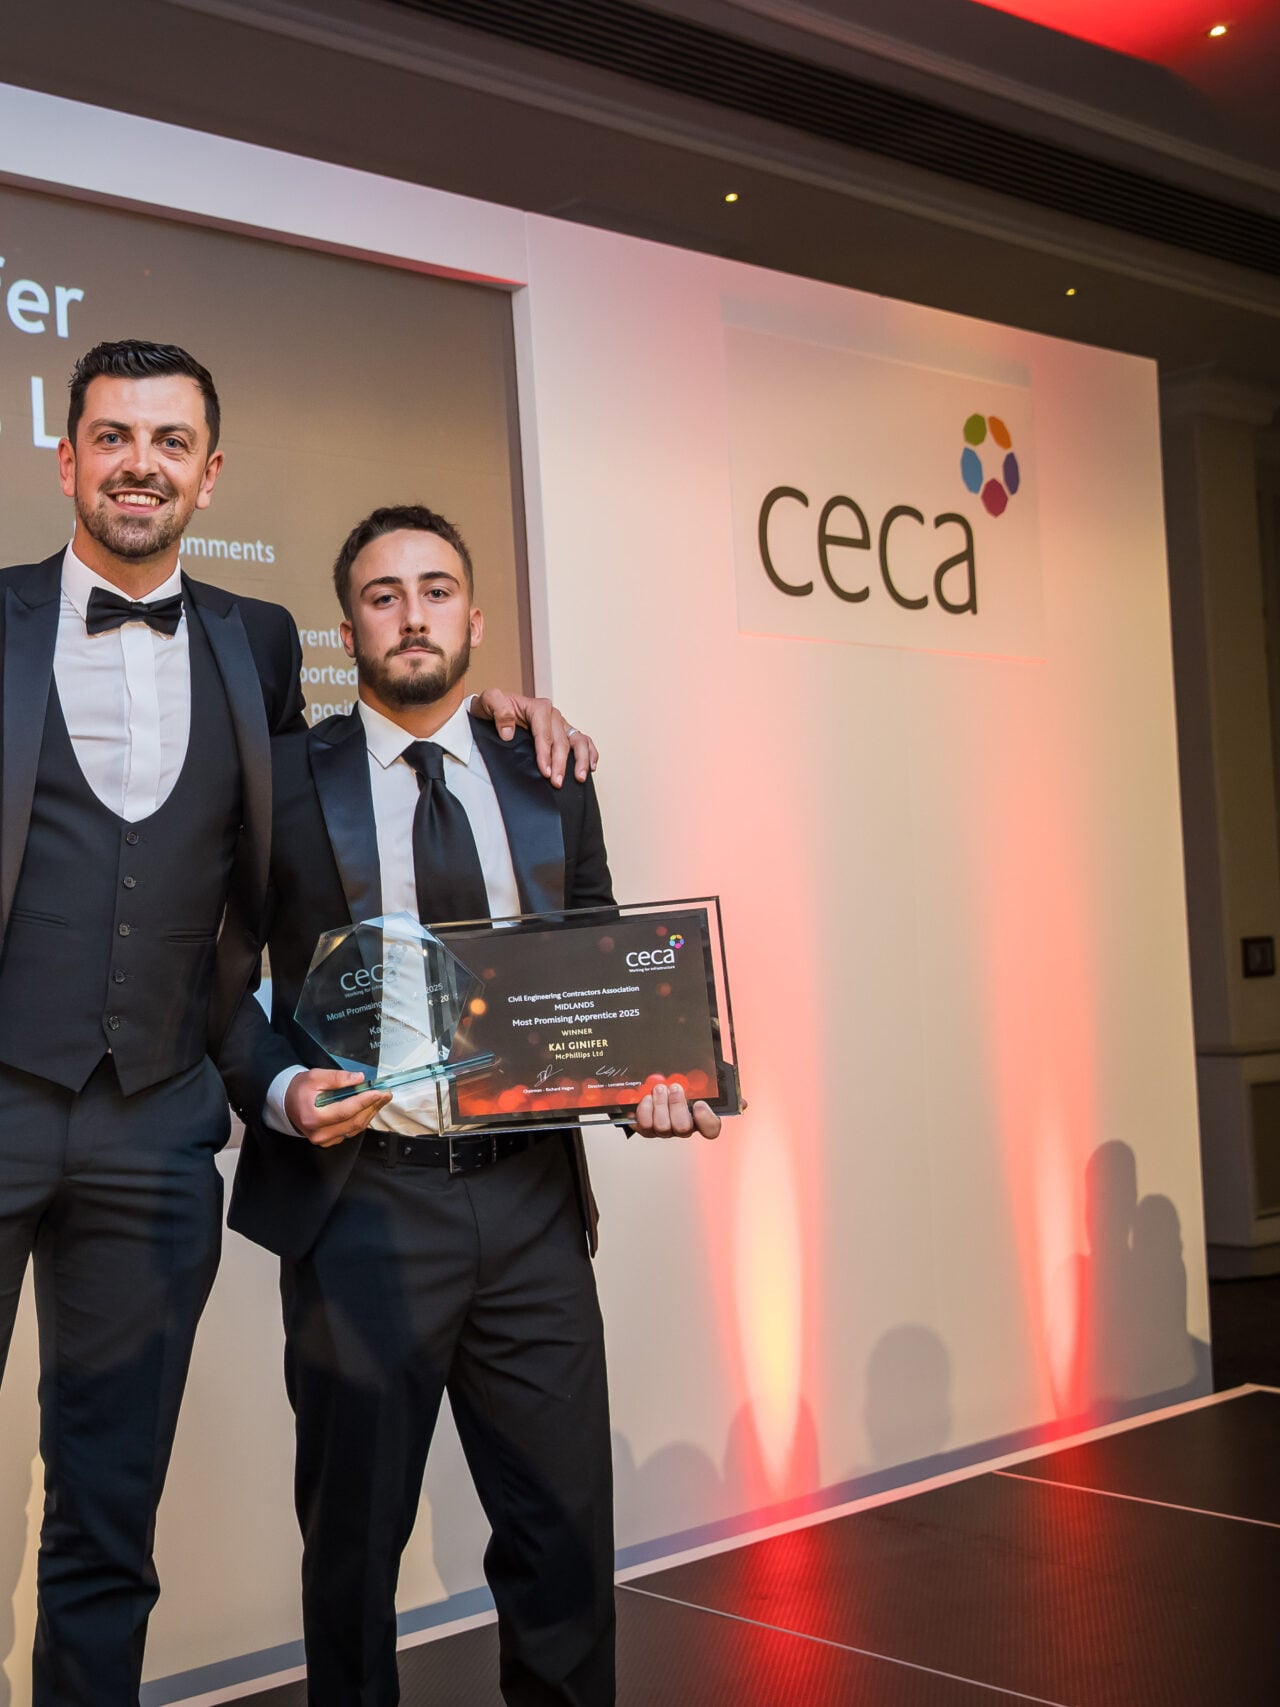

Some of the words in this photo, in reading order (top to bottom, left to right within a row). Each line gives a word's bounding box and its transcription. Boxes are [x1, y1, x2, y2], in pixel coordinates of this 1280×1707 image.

[758, 486, 977, 615] ceca
[625, 948, 675, 967] ceca
[508, 995, 523, 1003] Civil
[523, 992, 562, 1002] Engineering
[562, 989, 601, 998] Contractors
[601, 985, 640, 994] Association
[326, 1009, 345, 1022] Most
[346, 1001, 383, 1017] Promising
[554, 1001, 595, 1011] MIDLANDS
[512, 1018, 533, 1027] Most
[534, 1014, 573, 1025] Promising
[574, 1010, 617, 1022] Apprentice
[618, 1008, 640, 1018] 2025
[561, 1028, 593, 1037] WINNER
[548, 1042, 565, 1052] KAI
[568, 1039, 608, 1050] GINIFER
[555, 1052, 591, 1060] McPhillips
[592, 1050, 604, 1058] Ltd
